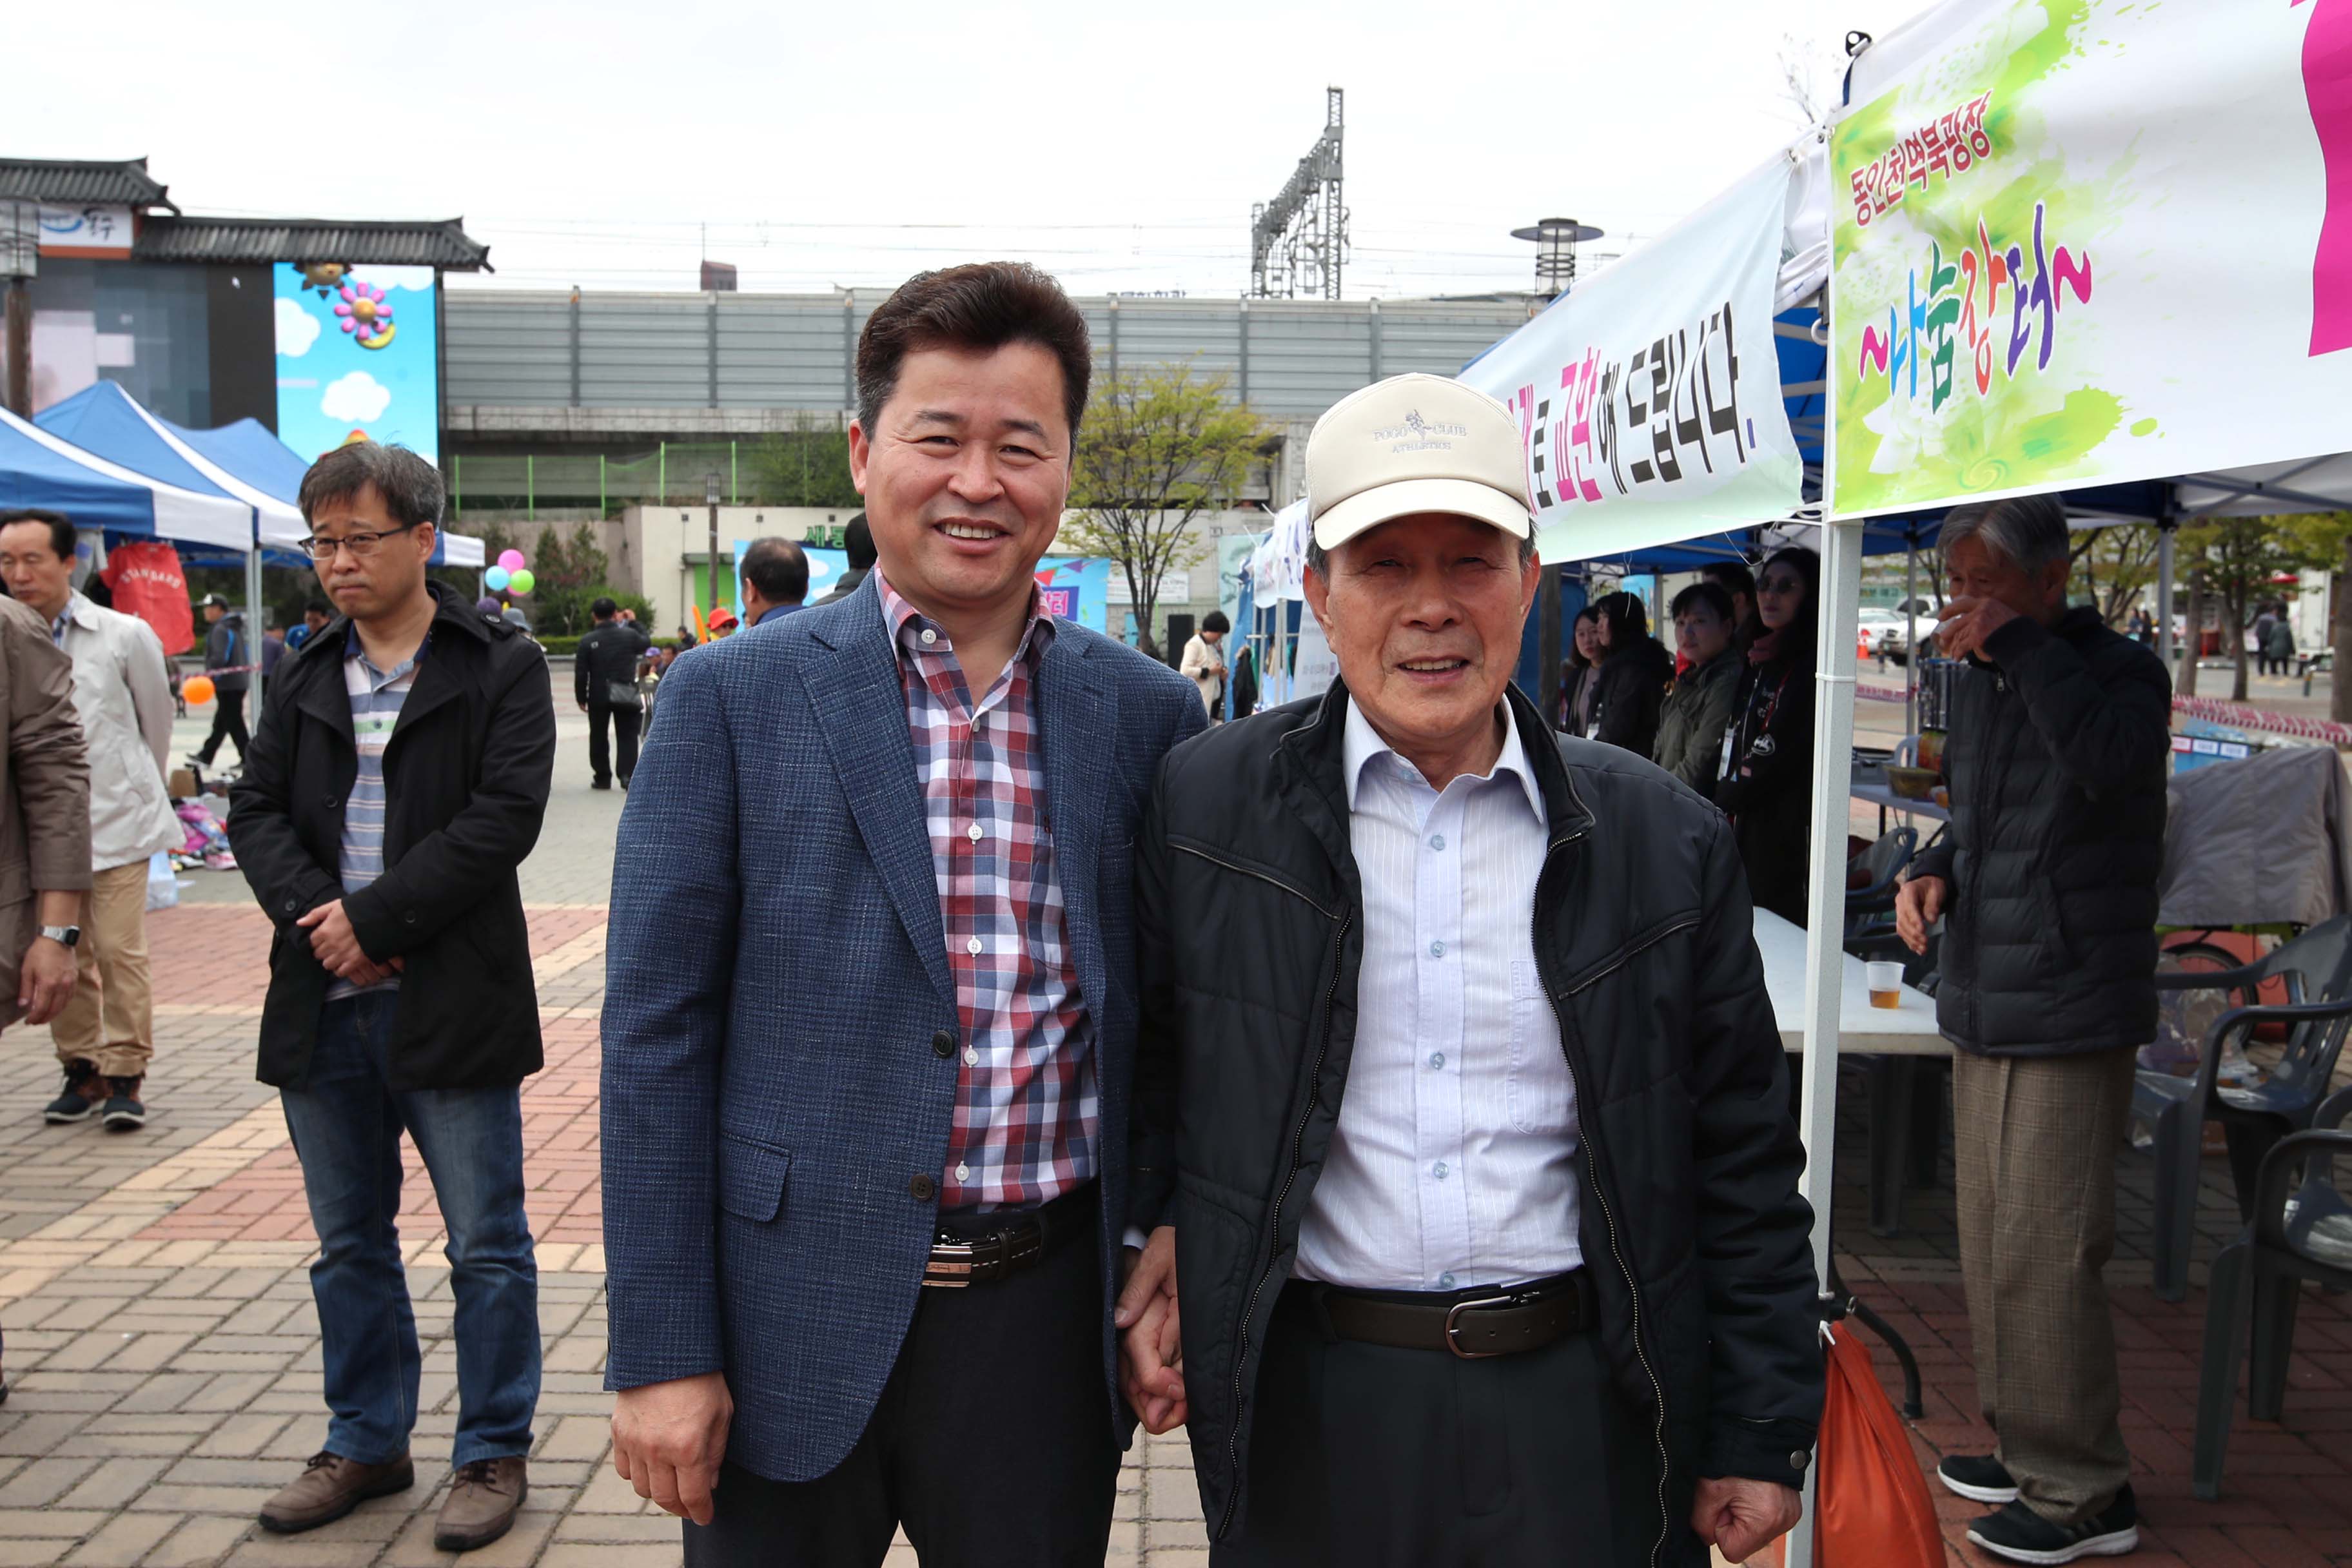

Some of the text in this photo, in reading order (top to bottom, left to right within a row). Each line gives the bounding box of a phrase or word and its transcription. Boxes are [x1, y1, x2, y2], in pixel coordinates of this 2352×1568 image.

[1850, 90, 1993, 226] 동인천역북광장
[1392, 441, 1451, 453] ATHLETICS
[1433, 423, 1467, 436] CLUB
[1507, 384, 1554, 516] 개로
